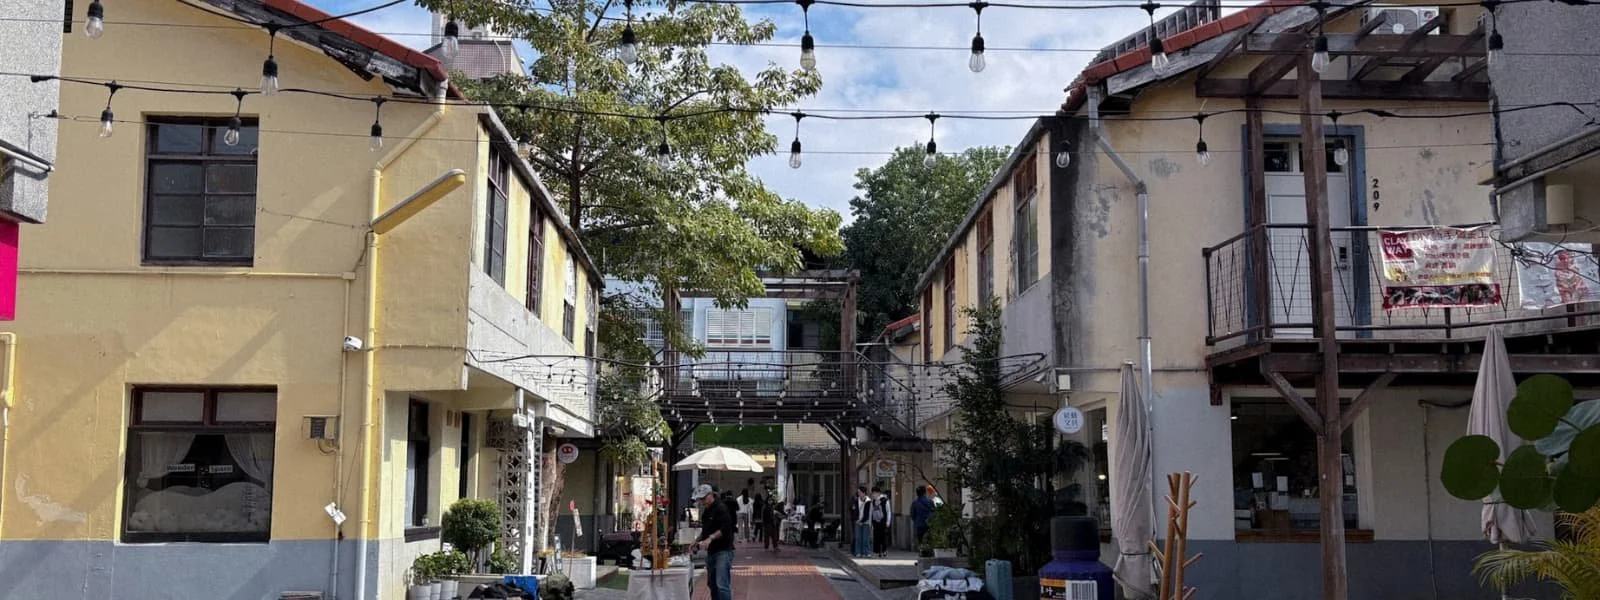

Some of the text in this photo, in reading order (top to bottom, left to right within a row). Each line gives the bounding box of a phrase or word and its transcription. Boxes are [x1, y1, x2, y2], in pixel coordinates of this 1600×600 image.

[1372, 178, 1380, 212] 209
[1384, 237, 1407, 246] CLAY
[1386, 245, 1408, 255] WAY
